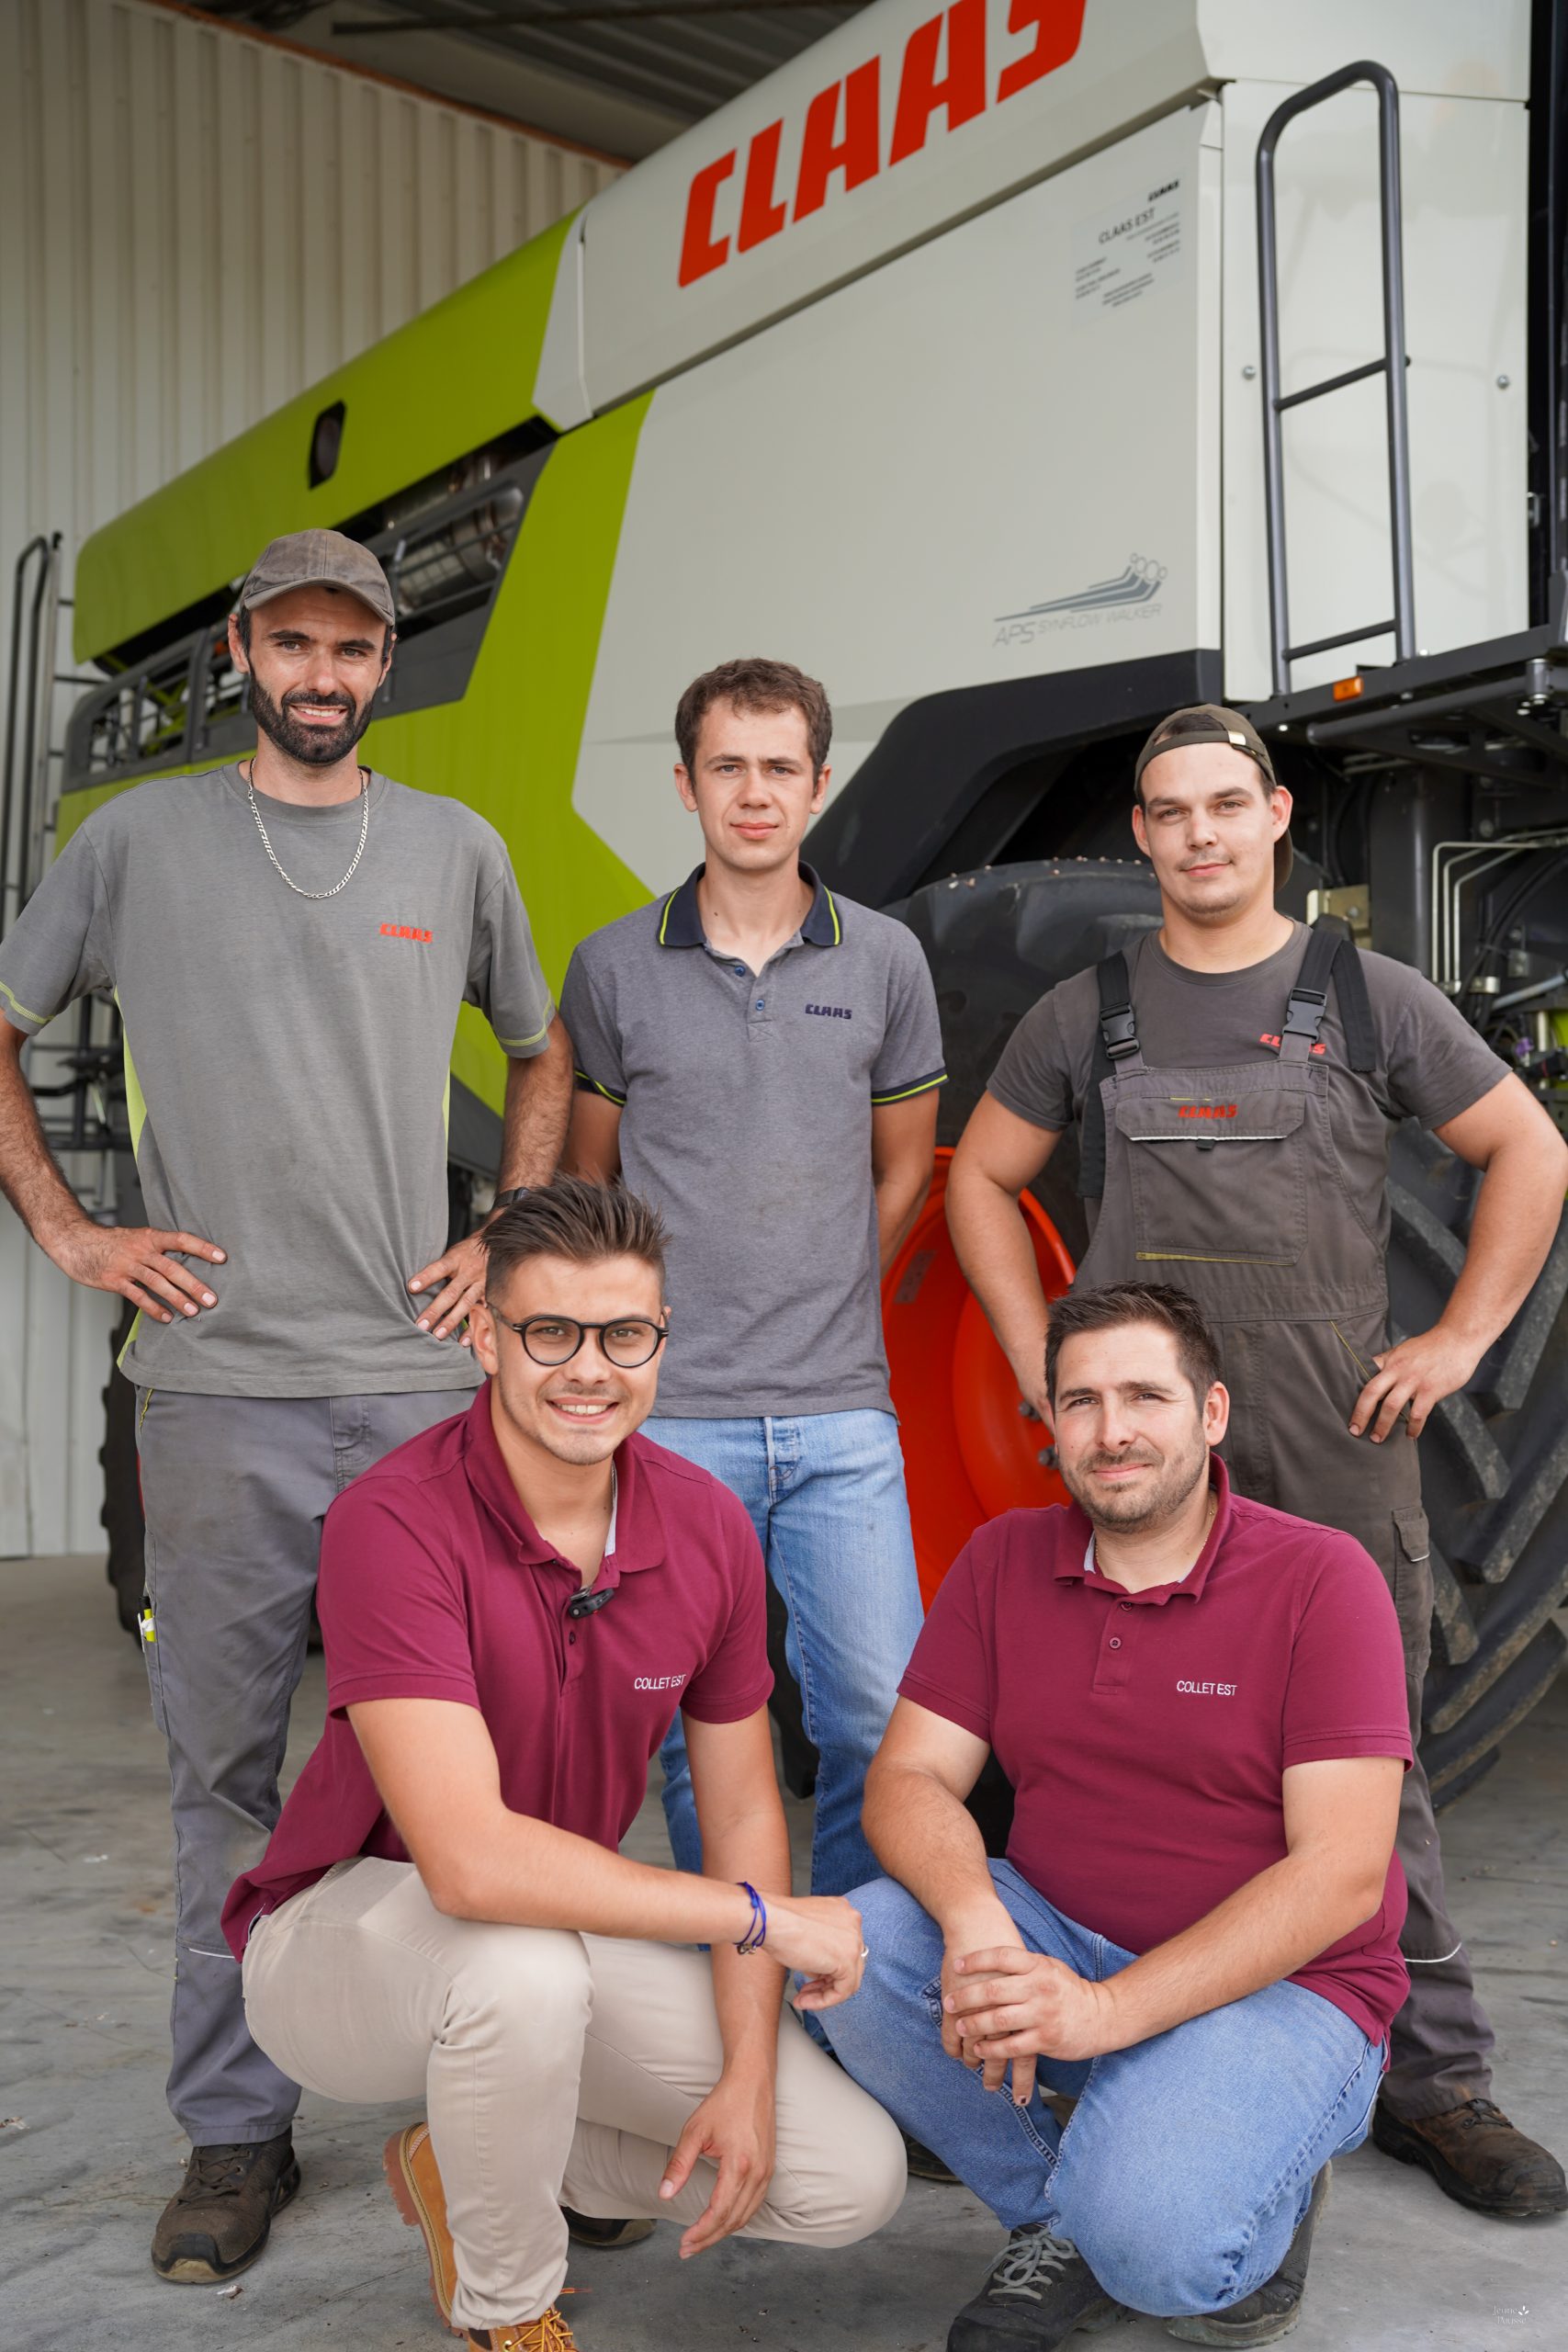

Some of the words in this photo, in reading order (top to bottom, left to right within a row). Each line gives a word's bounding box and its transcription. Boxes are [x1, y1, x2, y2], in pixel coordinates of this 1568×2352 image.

[678, 0, 1087, 288] CLAAS
[1099, 218, 1134, 244] CLAAS
[1134, 207, 1155, 226] EST
[992, 622, 1036, 648] APS
[1106, 603, 1162, 623] WALKER
[379, 922, 433, 944] CLAAS
[805, 1003, 852, 1020] CLAAS
[1259, 1033, 1326, 1055] CLS
[1178, 1104, 1237, 1119] CLAAS
[634, 1677, 671, 1690] COLLET
[671, 1674, 686, 1688] EST
[1176, 1679, 1216, 1695] COLLET
[1216, 1682, 1238, 1696] EST
